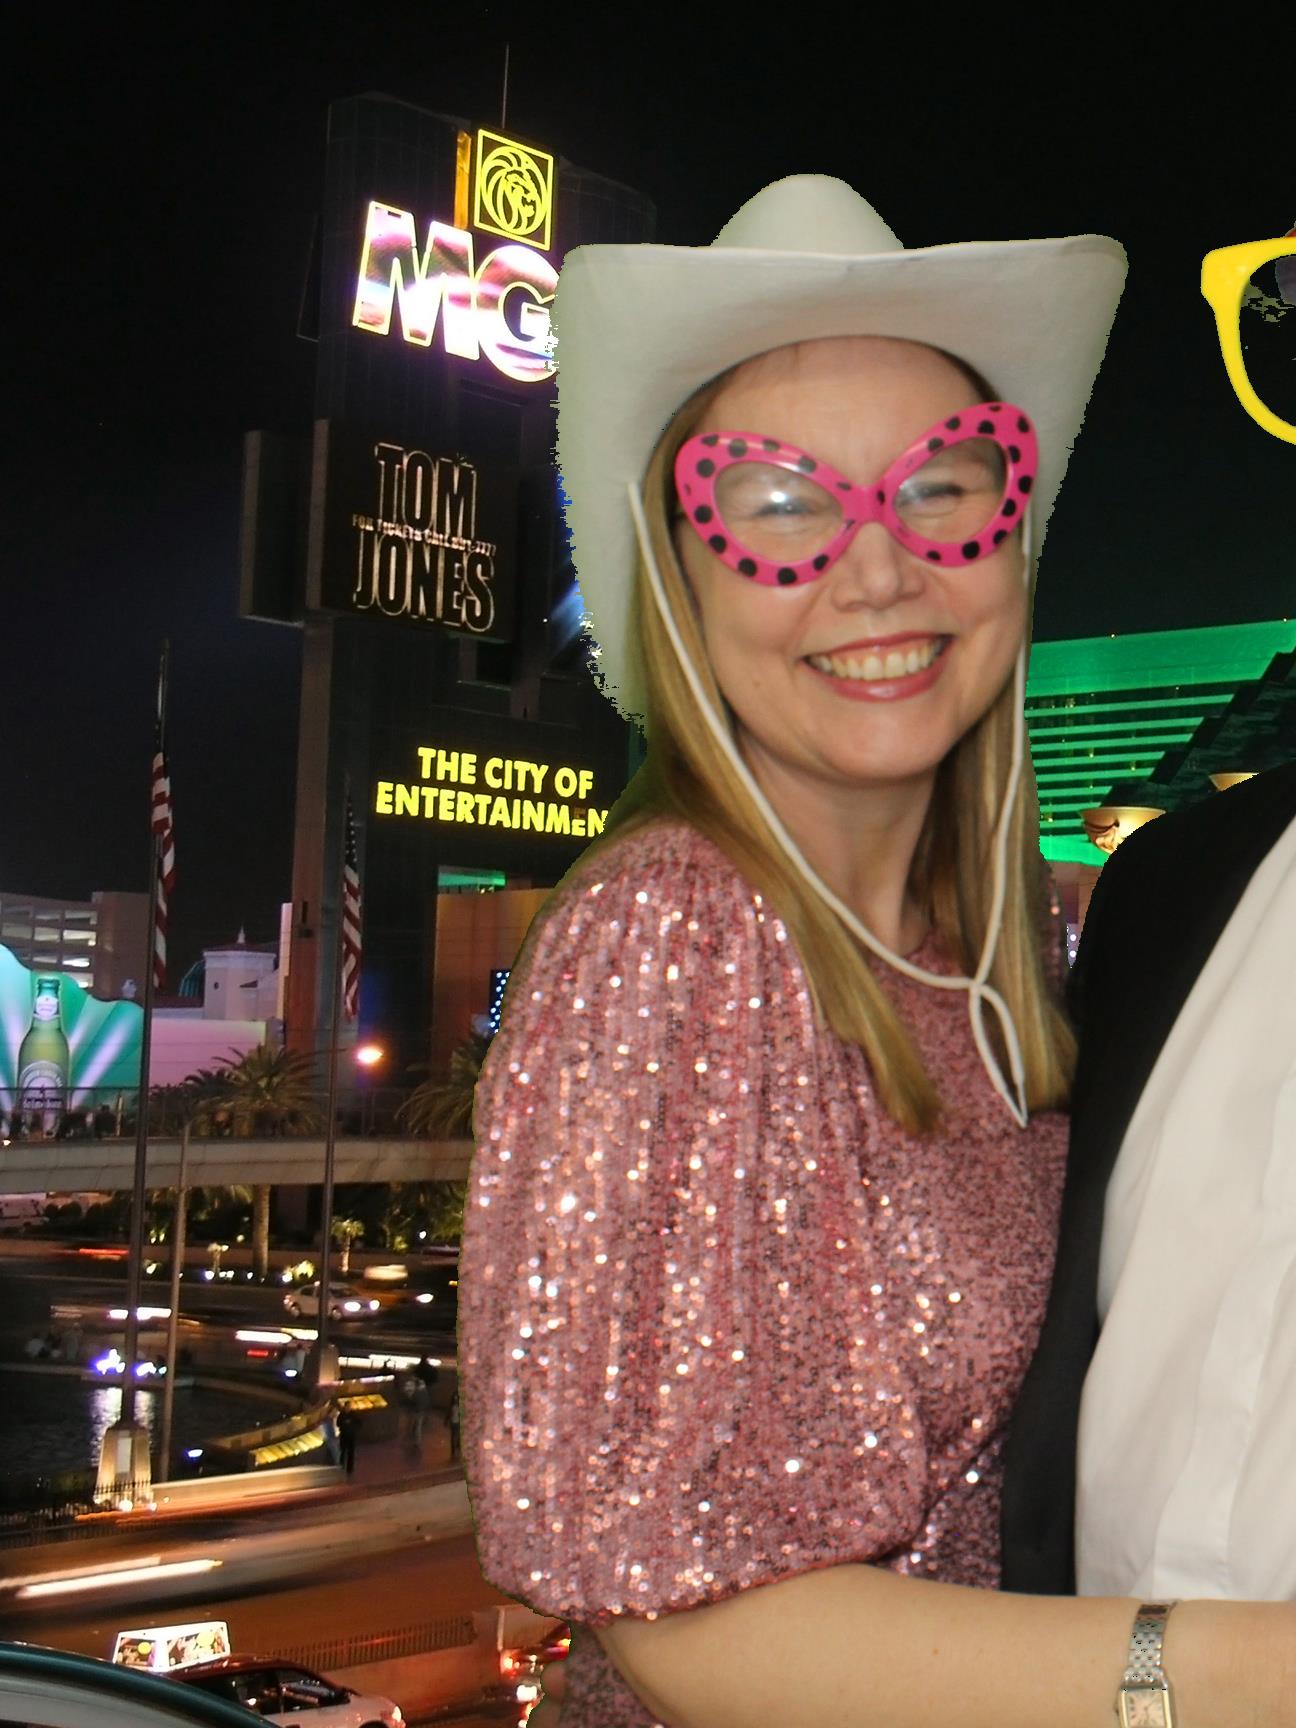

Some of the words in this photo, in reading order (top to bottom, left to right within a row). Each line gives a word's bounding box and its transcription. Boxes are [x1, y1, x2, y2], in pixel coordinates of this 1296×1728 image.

[352, 200, 559, 382] MG
[374, 442, 476, 540] TOM
[353, 530, 494, 632] JONES
[376, 781, 609, 838] ENTERTAINMEN
[417, 746, 477, 785] THE
[484, 757, 549, 794] CITY
[554, 767, 594, 800] OF
